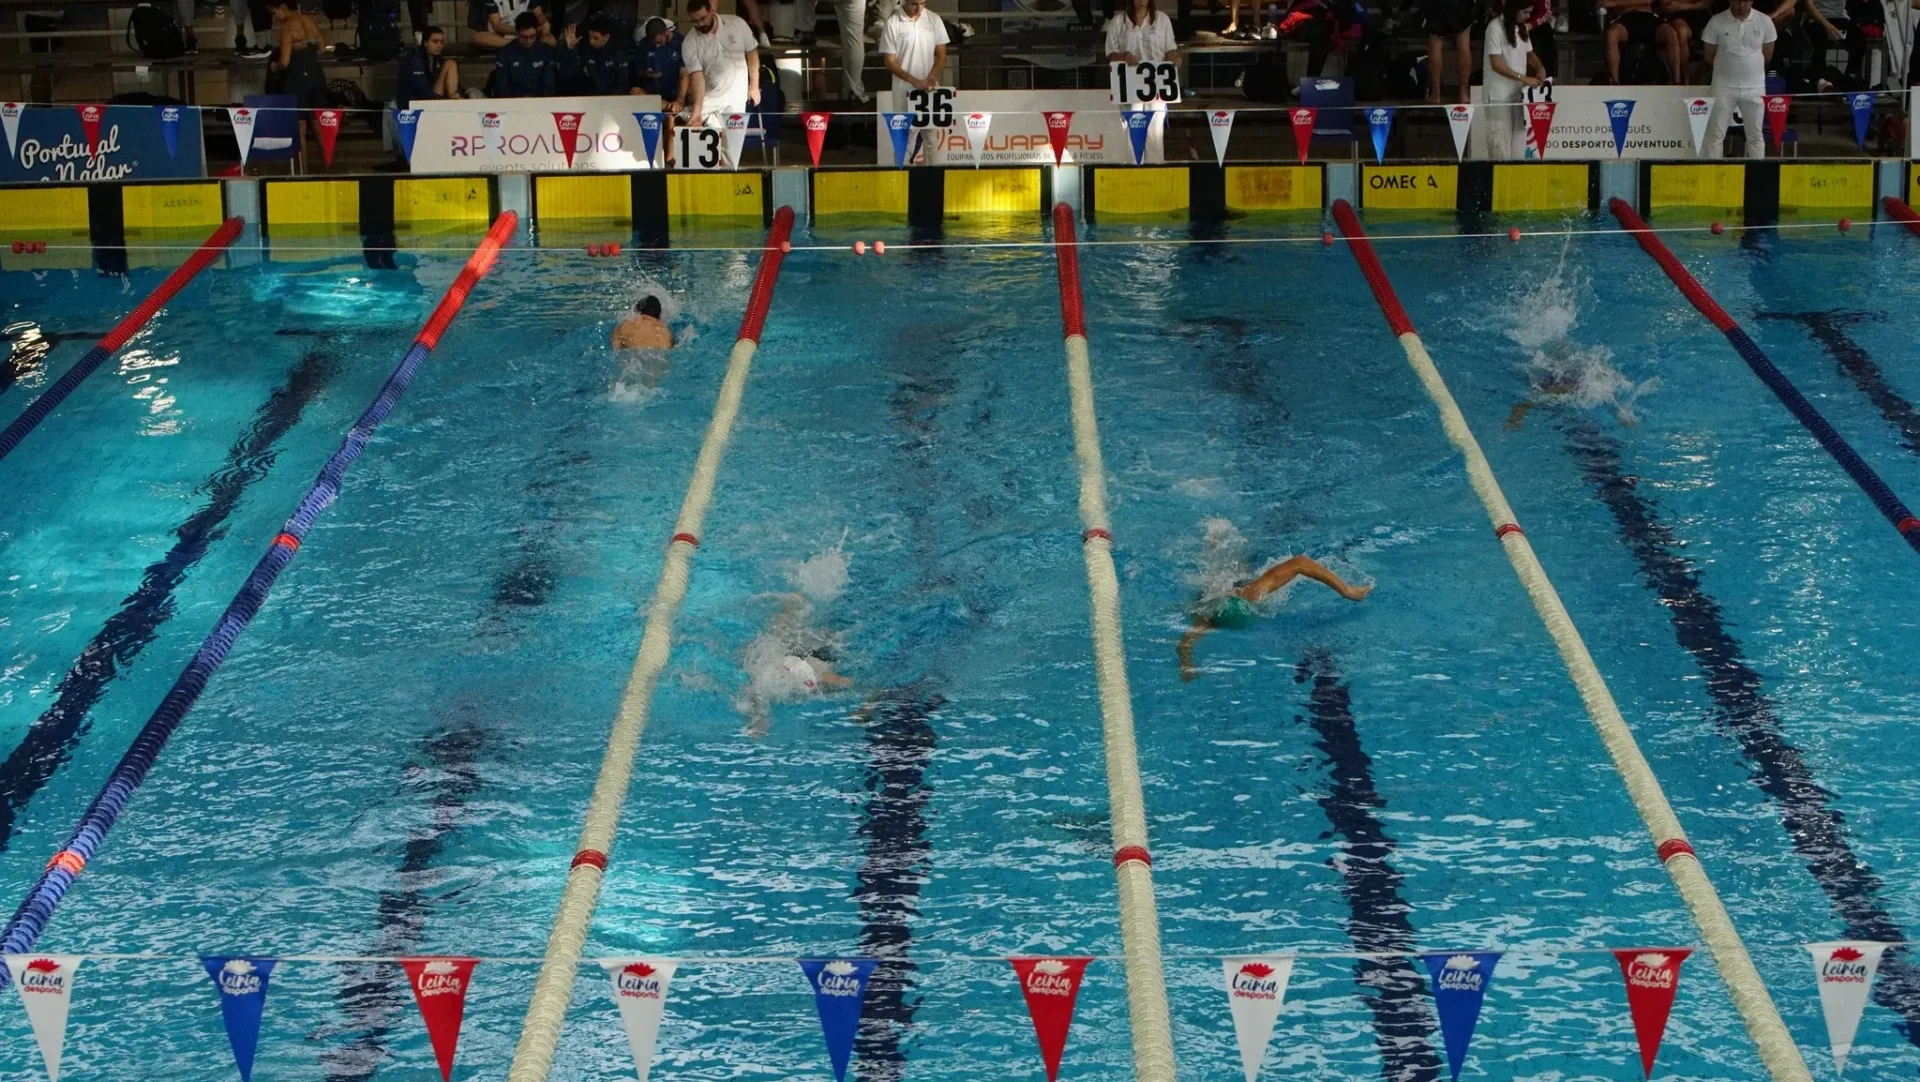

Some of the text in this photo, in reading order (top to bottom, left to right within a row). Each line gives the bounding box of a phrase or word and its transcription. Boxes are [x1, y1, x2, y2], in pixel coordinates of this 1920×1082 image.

[909, 89, 953, 128] 36
[1549, 125, 1593, 134] NSTITUTO
[680, 128, 720, 168] 13
[1562, 140, 1615, 149] DESPORTO
[531, 160, 597, 171] solutons
[1438, 967, 1482, 985] Leiria
[1627, 961, 1673, 982] Leiria
[1822, 961, 1868, 977] Leiria
[21, 970, 64, 989] Leiria
[219, 970, 262, 989] Leiria
[418, 973, 461, 990] Leiria
[618, 973, 660, 993] Leiria
[817, 971, 860, 991] Leiria
[1026, 972, 1071, 991] Leiria
[1232, 972, 1278, 993] Leiria
